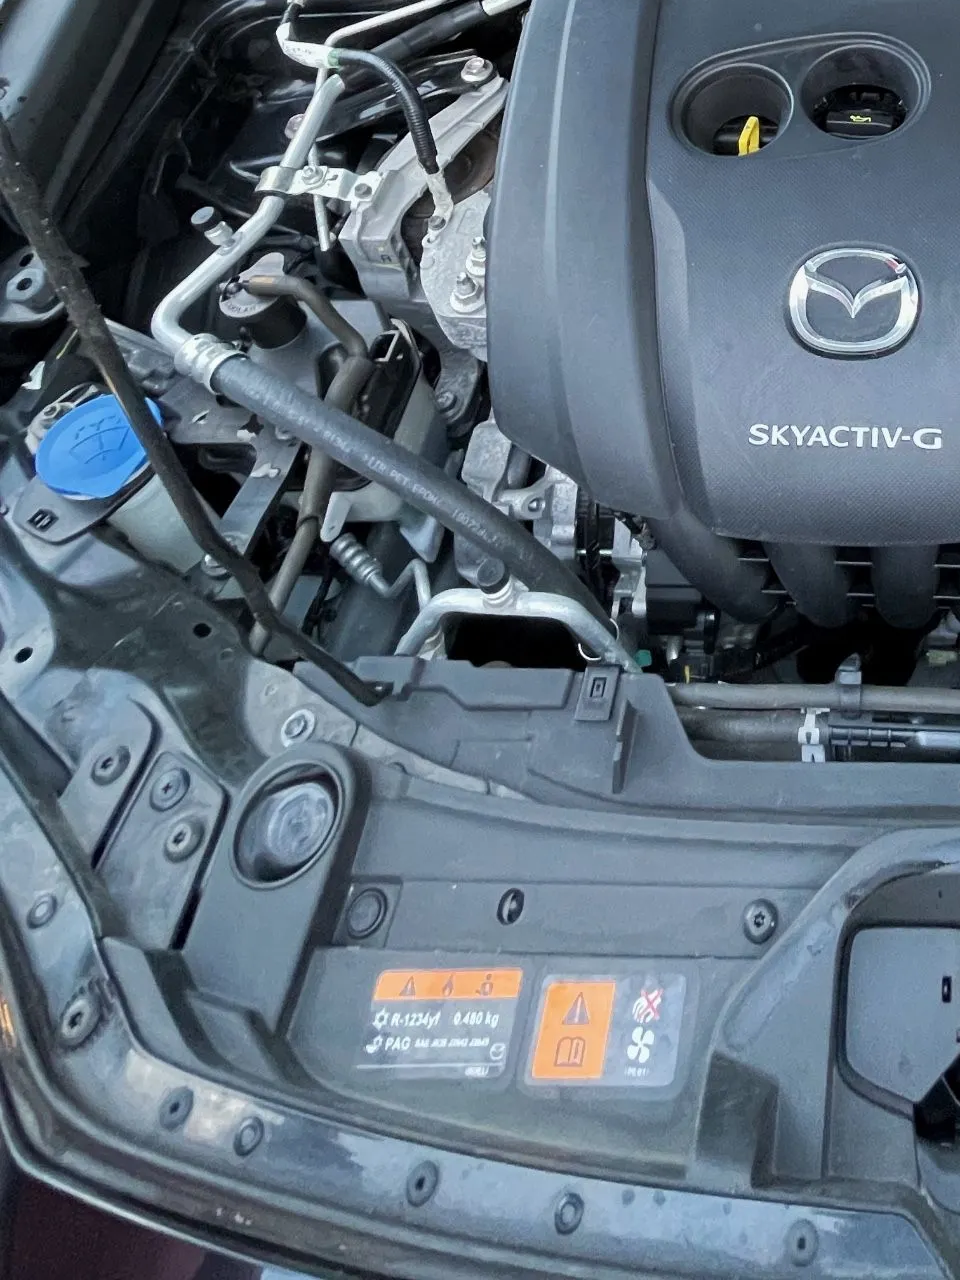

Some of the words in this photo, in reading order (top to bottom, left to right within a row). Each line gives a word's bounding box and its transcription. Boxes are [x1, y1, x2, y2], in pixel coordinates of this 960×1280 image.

[748, 423, 943, 450] SKYACTIV-G
[485, 1010, 500, 1029] kg
[384, 1035, 411, 1051] PAG
